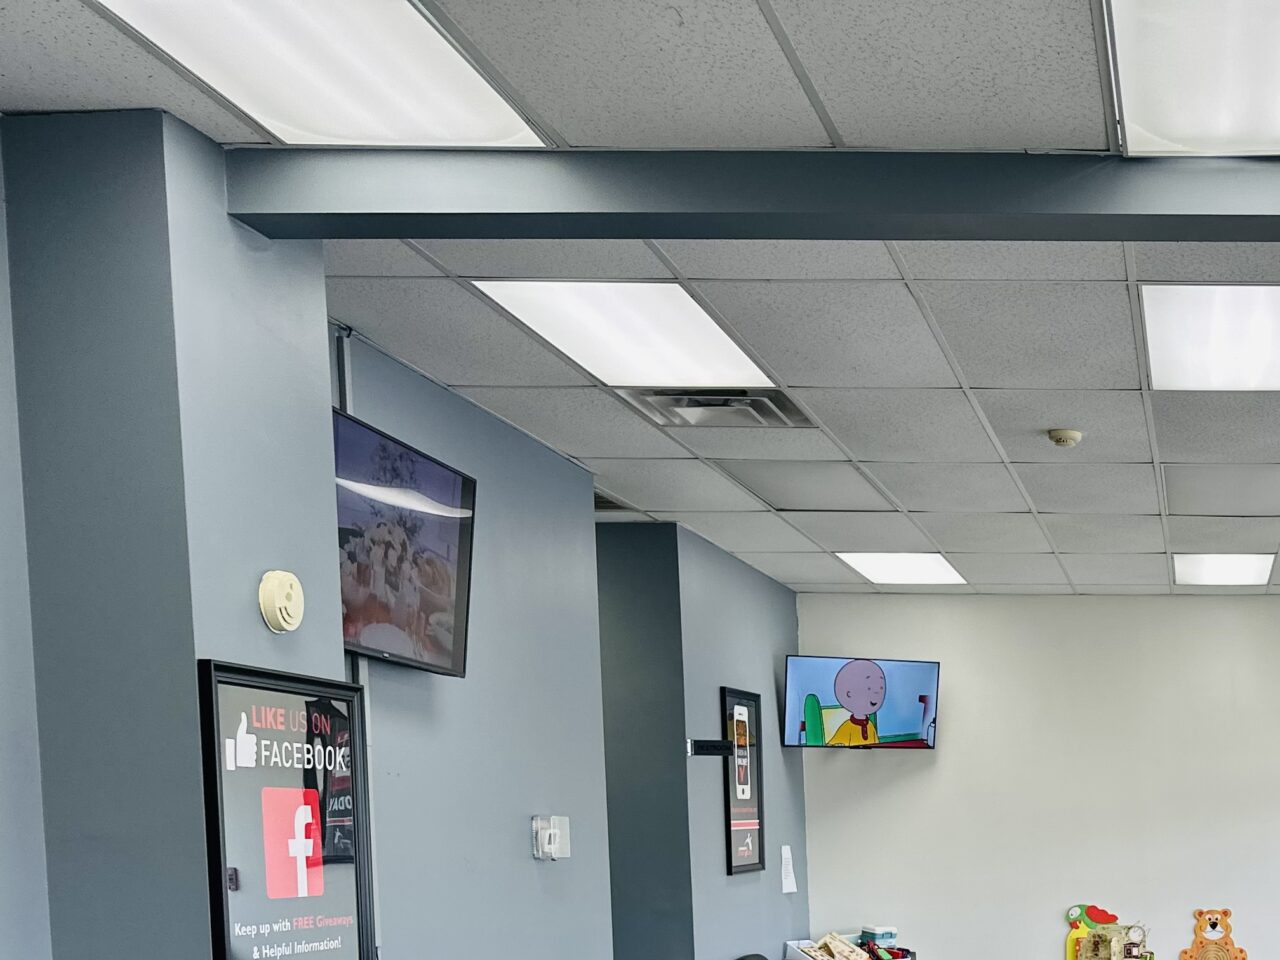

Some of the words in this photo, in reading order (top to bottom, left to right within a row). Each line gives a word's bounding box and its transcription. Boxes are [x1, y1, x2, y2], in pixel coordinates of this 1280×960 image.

[252, 704, 286, 731] LIKE
[289, 712, 307, 732] US
[312, 712, 331, 735] ON
[260, 739, 347, 771] FACEBOOK
[235, 921, 257, 938] Keep
[259, 923, 271, 938] up
[272, 919, 292, 932] with
[293, 916, 314, 929] FREE
[316, 914, 353, 929] Giveaways
[252, 947, 260, 959] &
[262, 941, 292, 960] Helpful
[294, 936, 342, 954] Information!
